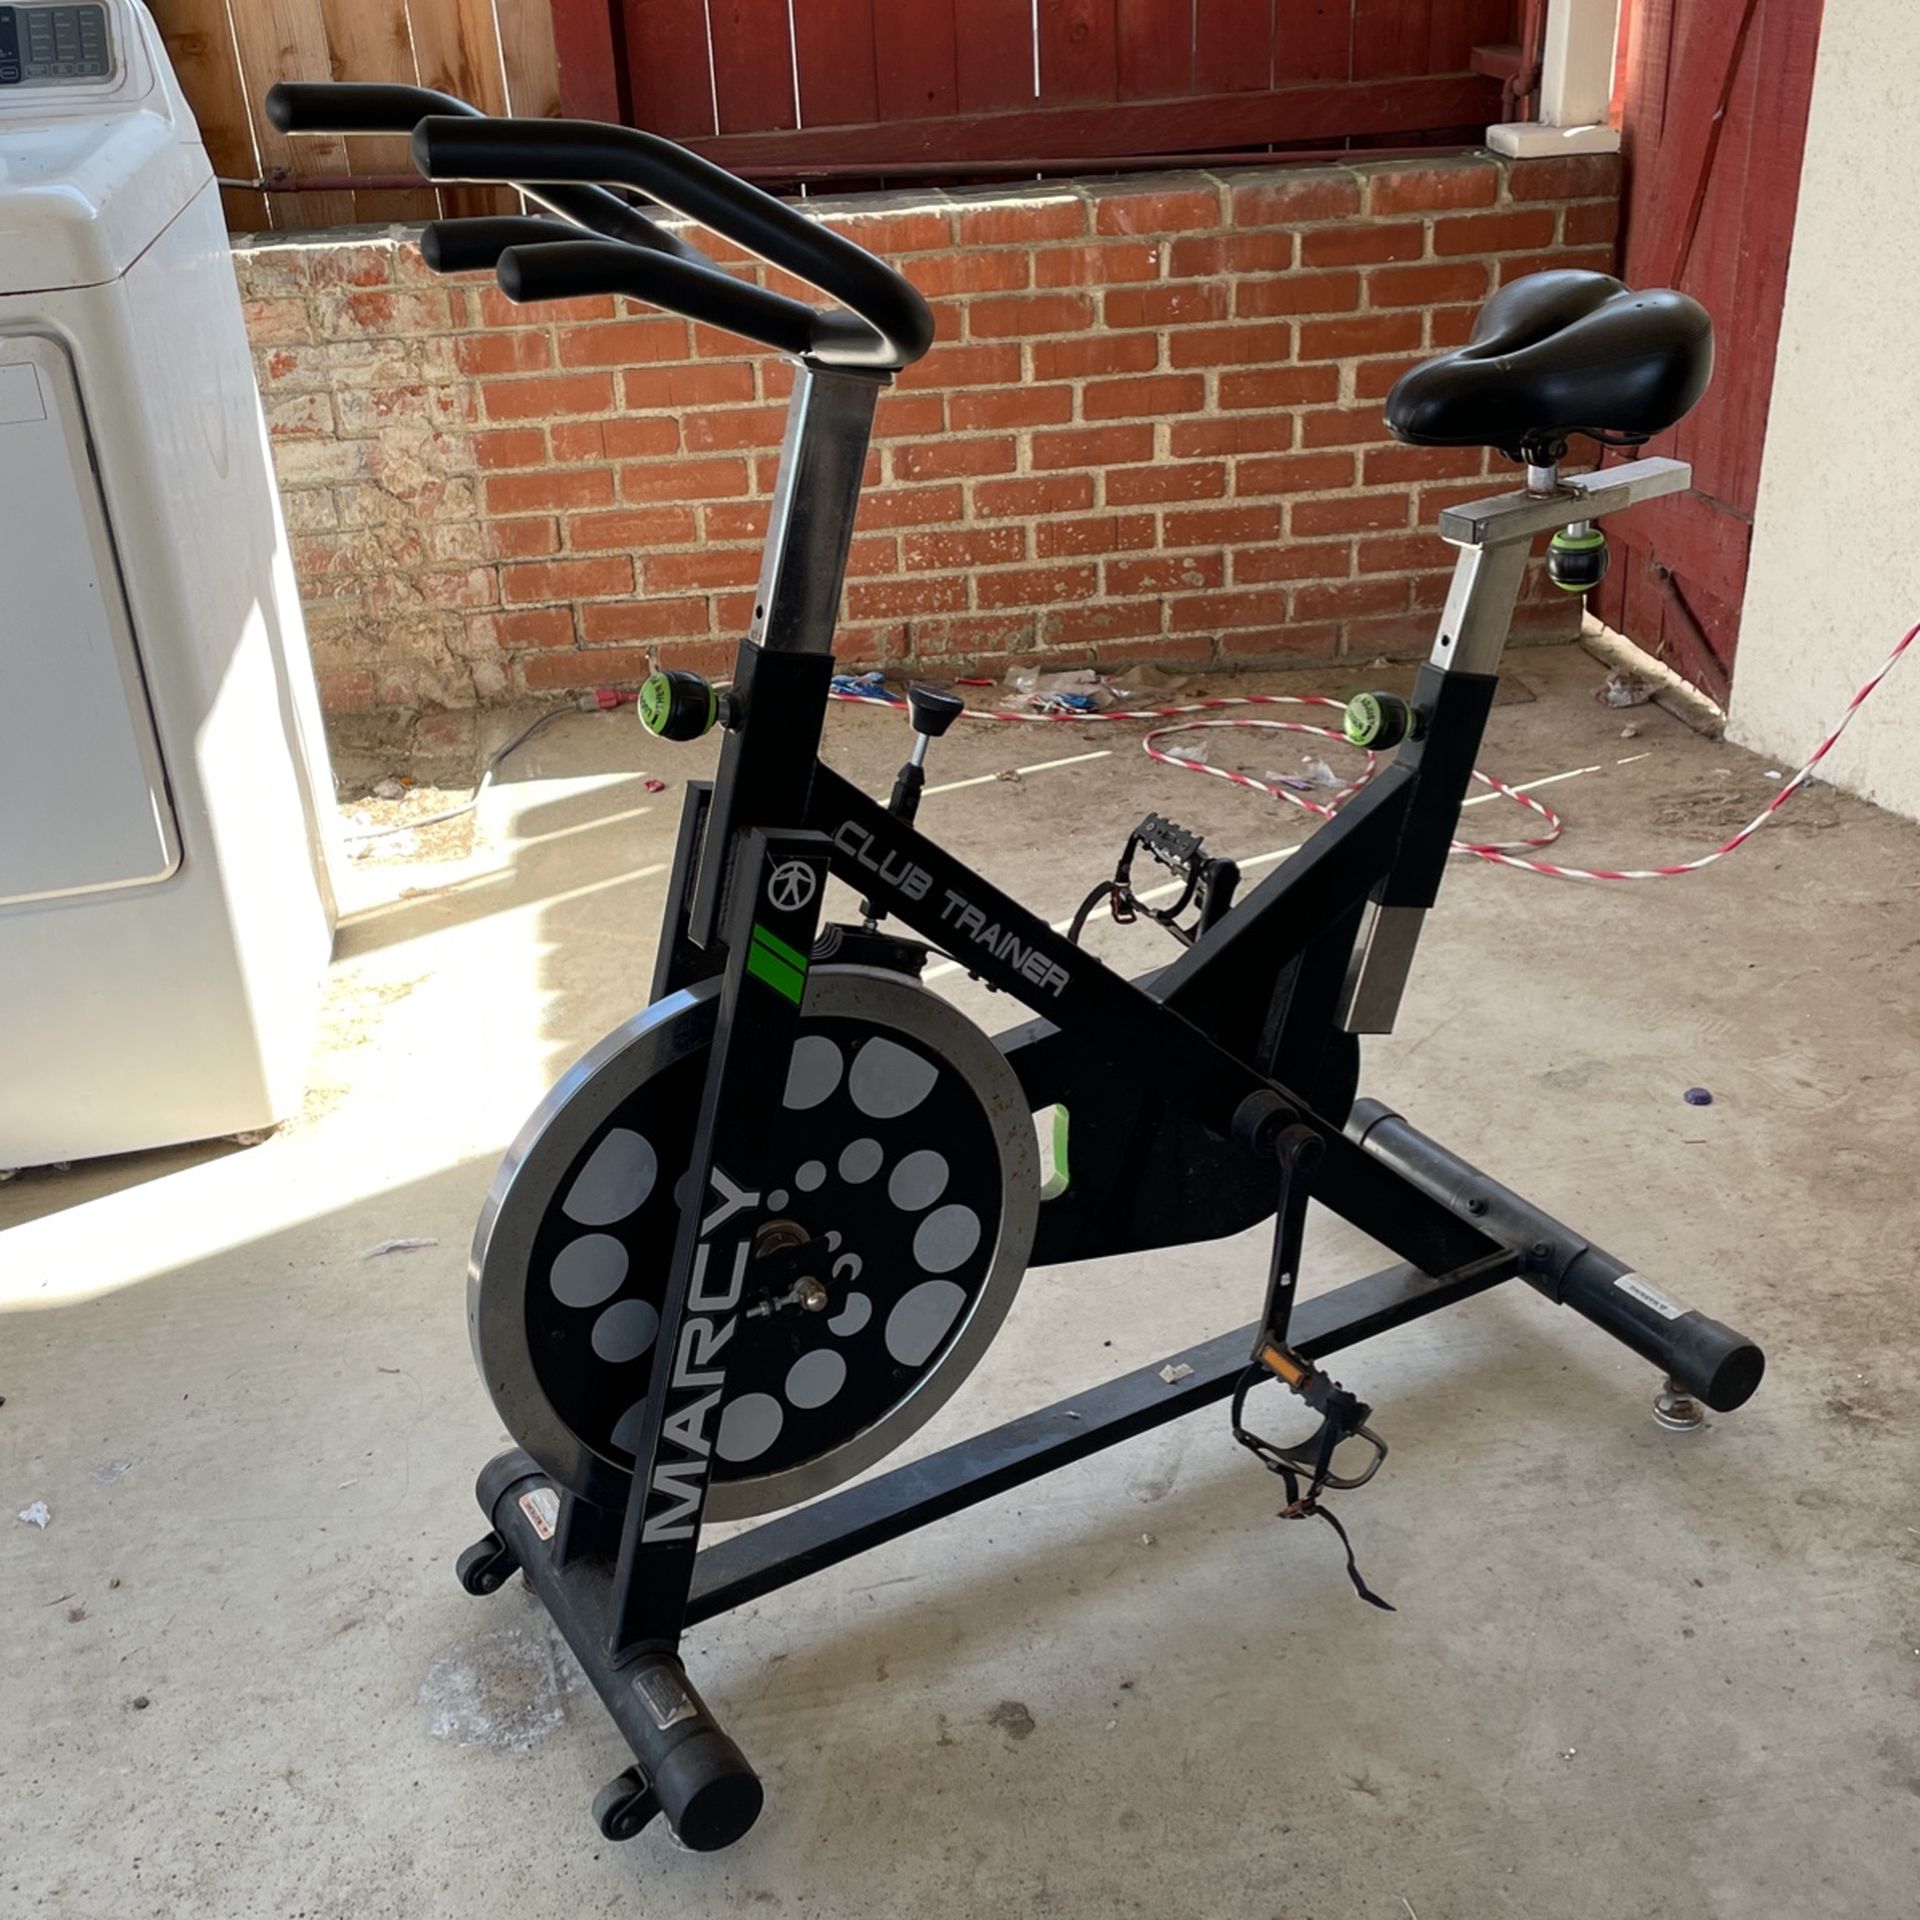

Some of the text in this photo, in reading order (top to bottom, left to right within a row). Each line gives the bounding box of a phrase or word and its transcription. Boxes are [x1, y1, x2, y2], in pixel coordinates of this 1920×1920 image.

[834, 819, 1071, 998] CLUB TRAINER
[641, 1166, 761, 1544] MARCY
